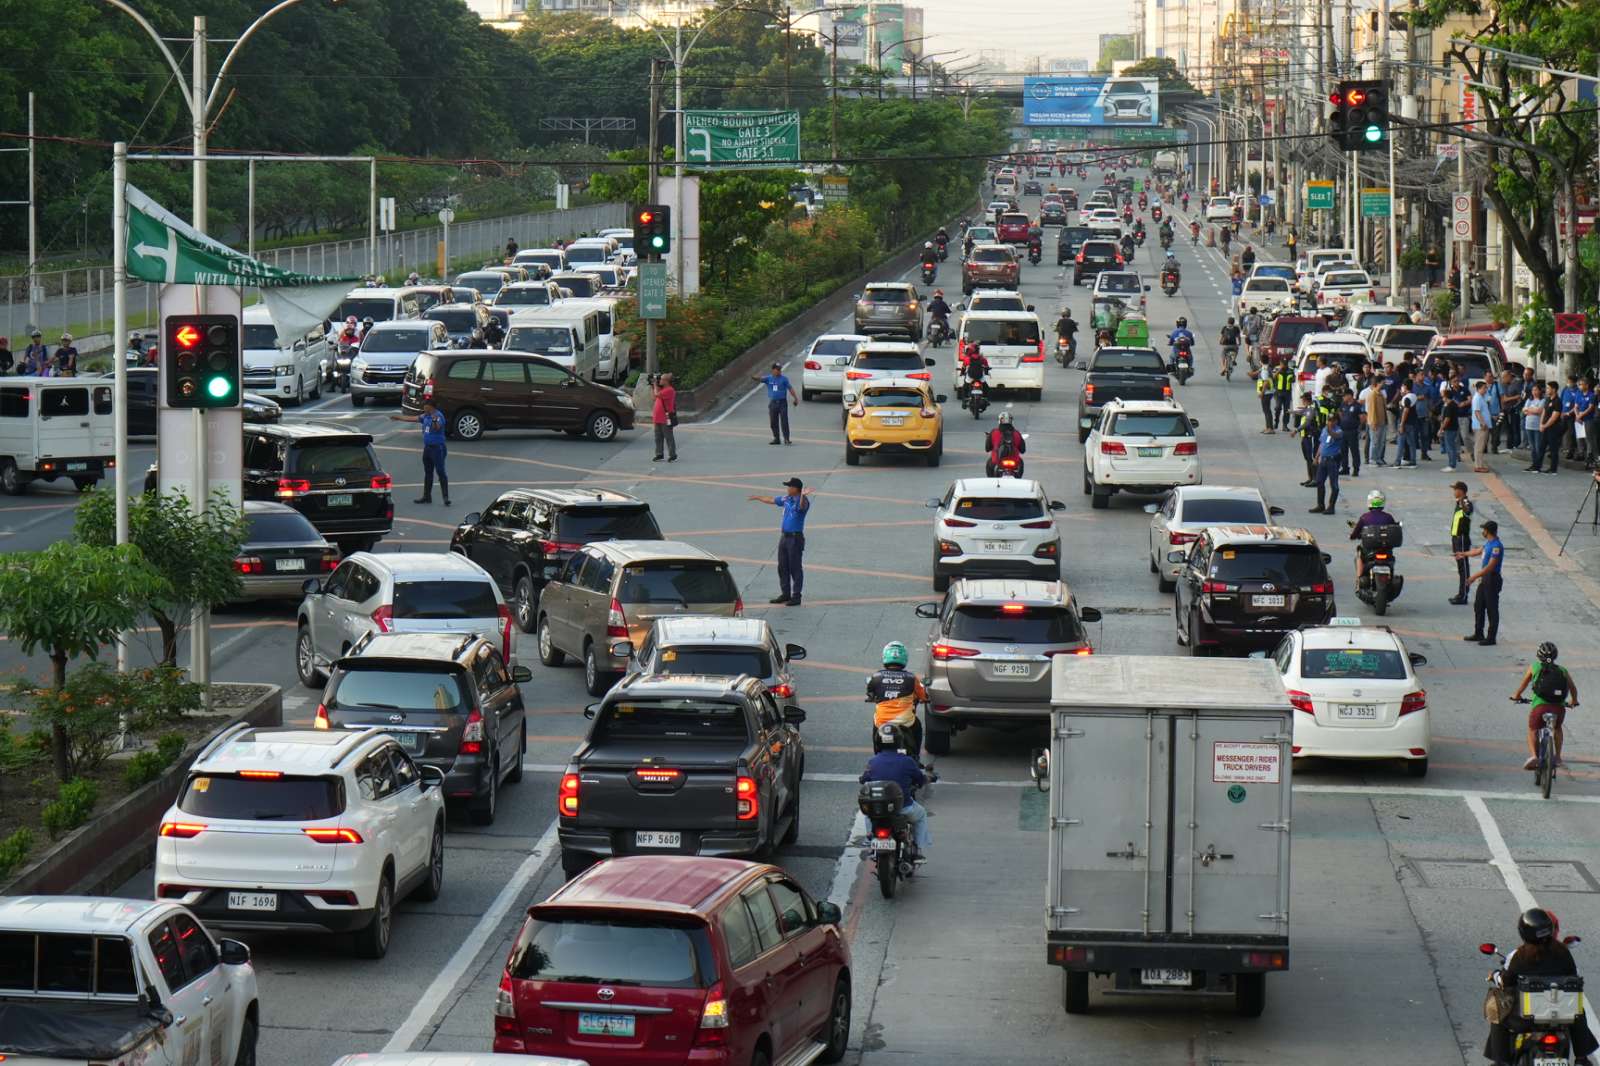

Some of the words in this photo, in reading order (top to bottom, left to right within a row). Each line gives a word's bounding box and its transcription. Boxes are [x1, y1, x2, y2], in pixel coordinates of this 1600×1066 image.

[739, 127, 761, 138] GATE
[735, 147, 758, 159] GATE
[194, 271, 228, 286] WITH
[993, 664, 1007, 673] NGF
[1011, 664, 1029, 674] 9258
[1340, 707, 1353, 716] NCJ
[1357, 707, 1375, 716] 3521
[1216, 755, 1254, 763] MESSENGER
[1259, 756, 1277, 764] RIDER
[1223, 763, 1243, 771] TRUCK
[1245, 764, 1271, 772] DRIVERS
[637, 835, 653, 845] NFP
[658, 835, 680, 845] 5609
[229, 894, 247, 906] NIF
[252, 895, 275, 908] 1696
